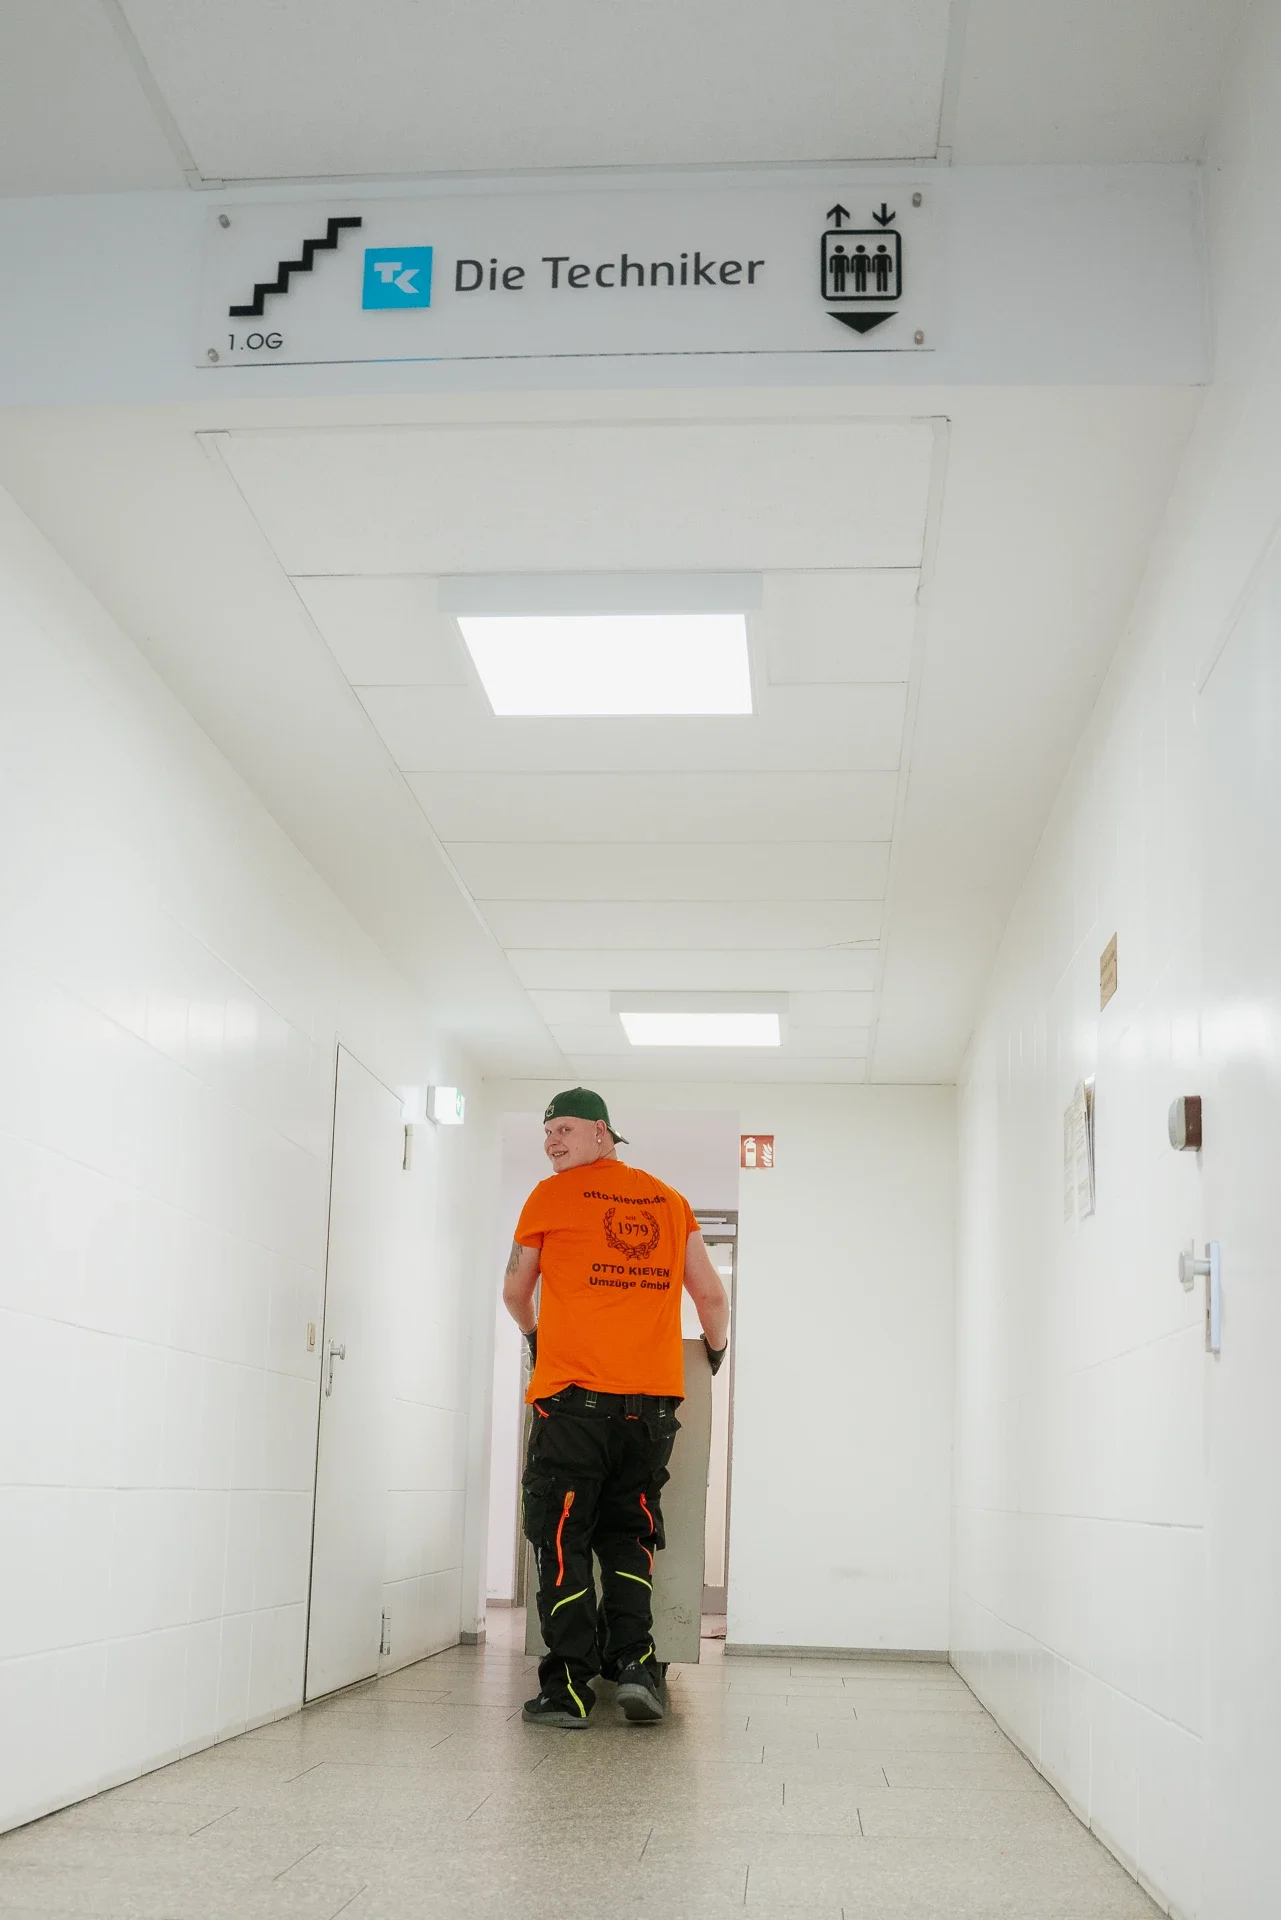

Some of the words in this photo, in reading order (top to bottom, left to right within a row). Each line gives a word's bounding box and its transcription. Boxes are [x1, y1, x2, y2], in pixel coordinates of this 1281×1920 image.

[374, 262, 420, 293] TK
[454, 258, 526, 292] Die
[541, 252, 766, 290] Techniker
[228, 332, 283, 350] 1.OG
[583, 1190, 666, 1205] otto-kieven.de
[618, 1221, 649, 1237] 1979
[592, 1263, 625, 1275] OTTO
[628, 1266, 670, 1278] KIEVEN
[589, 1276, 637, 1290] Umzüge
[640, 1279, 671, 1291] GmbH
